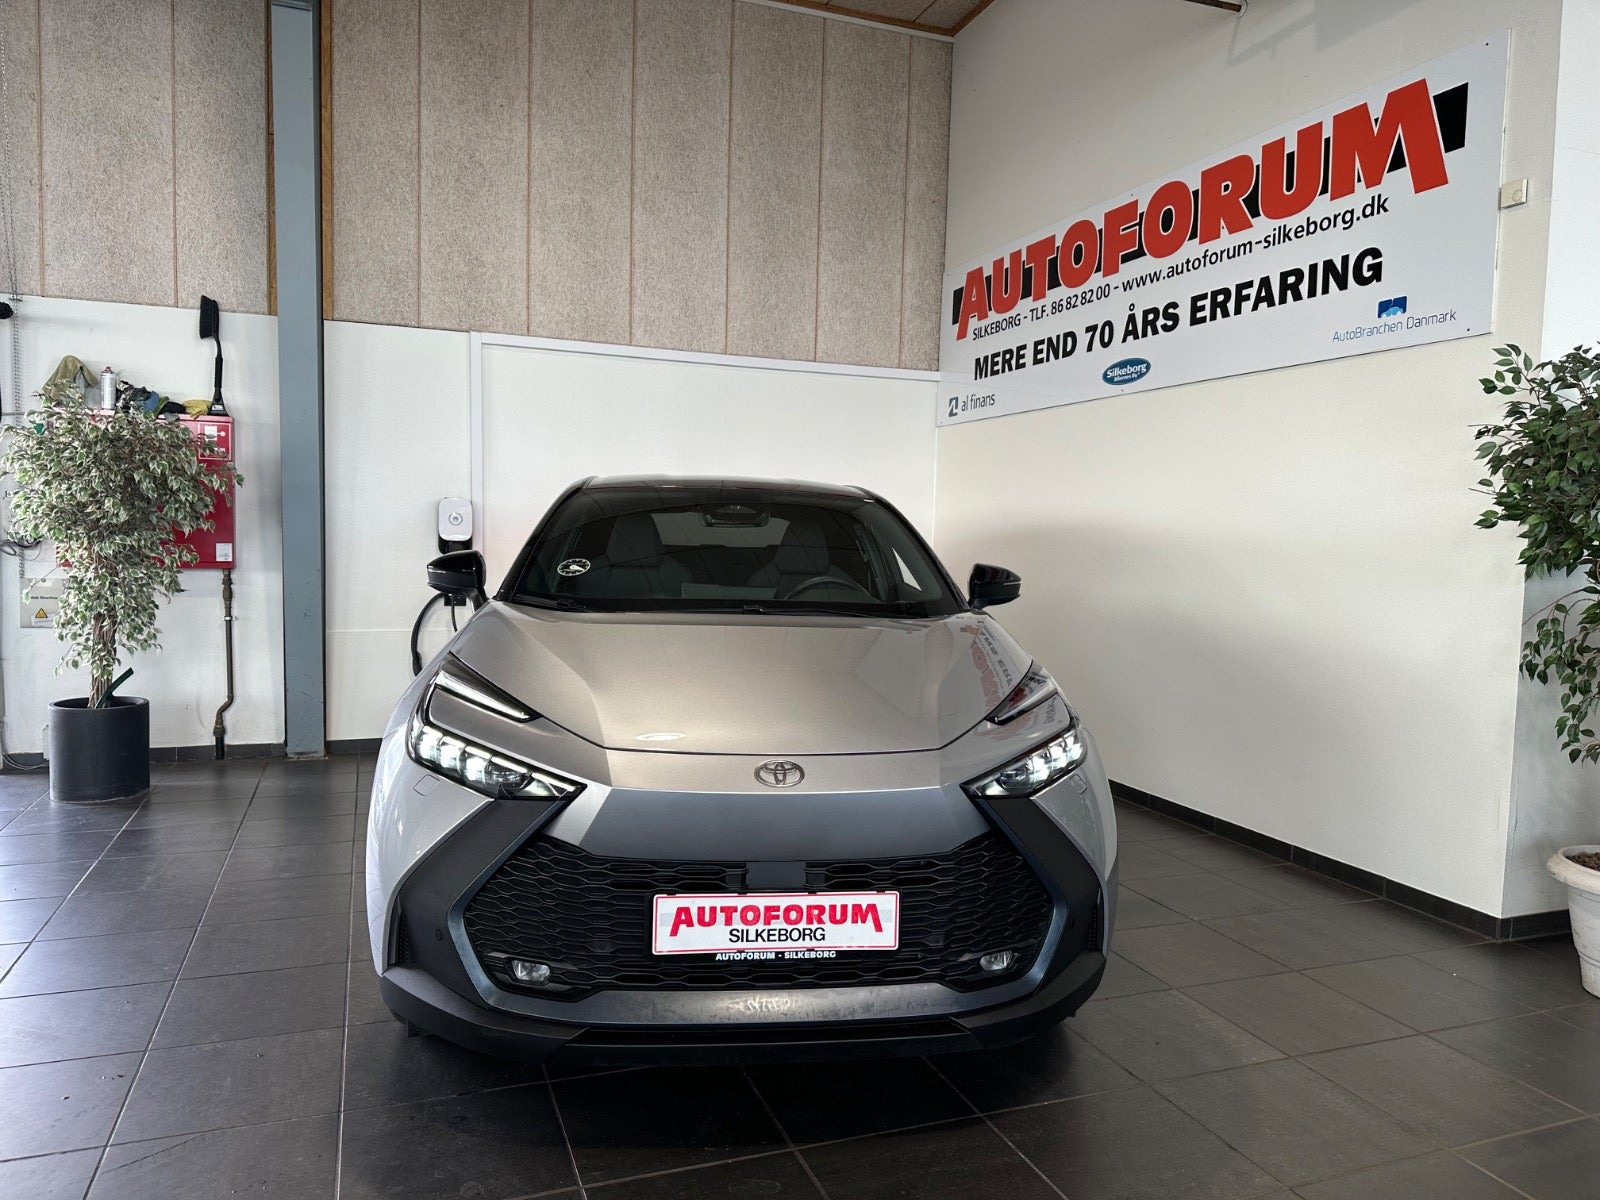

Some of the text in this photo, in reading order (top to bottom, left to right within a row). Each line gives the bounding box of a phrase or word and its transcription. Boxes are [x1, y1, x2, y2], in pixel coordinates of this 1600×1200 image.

[956, 77, 1449, 341] AUTOFORUM
[972, 313, 1021, 341] SILKEBORG
[1029, 304, 1049, 322] TLF.
[1121, 193, 1389, 293] www.autoforum-silkeborg.dk
[974, 246, 1384, 381] MERE END 70 ÅRS ERFARING
[1332, 309, 1457, 343] AutoBranchen Danmark
[1106, 363, 1148, 379] Silkeborg
[961, 393, 996, 412] al finans
[669, 903, 884, 937] AUTOFORUM
[728, 927, 826, 943] SILKEBORG
[715, 951, 776, 961] AUTOFORUM
[784, 950, 837, 959] SILKEBORG
